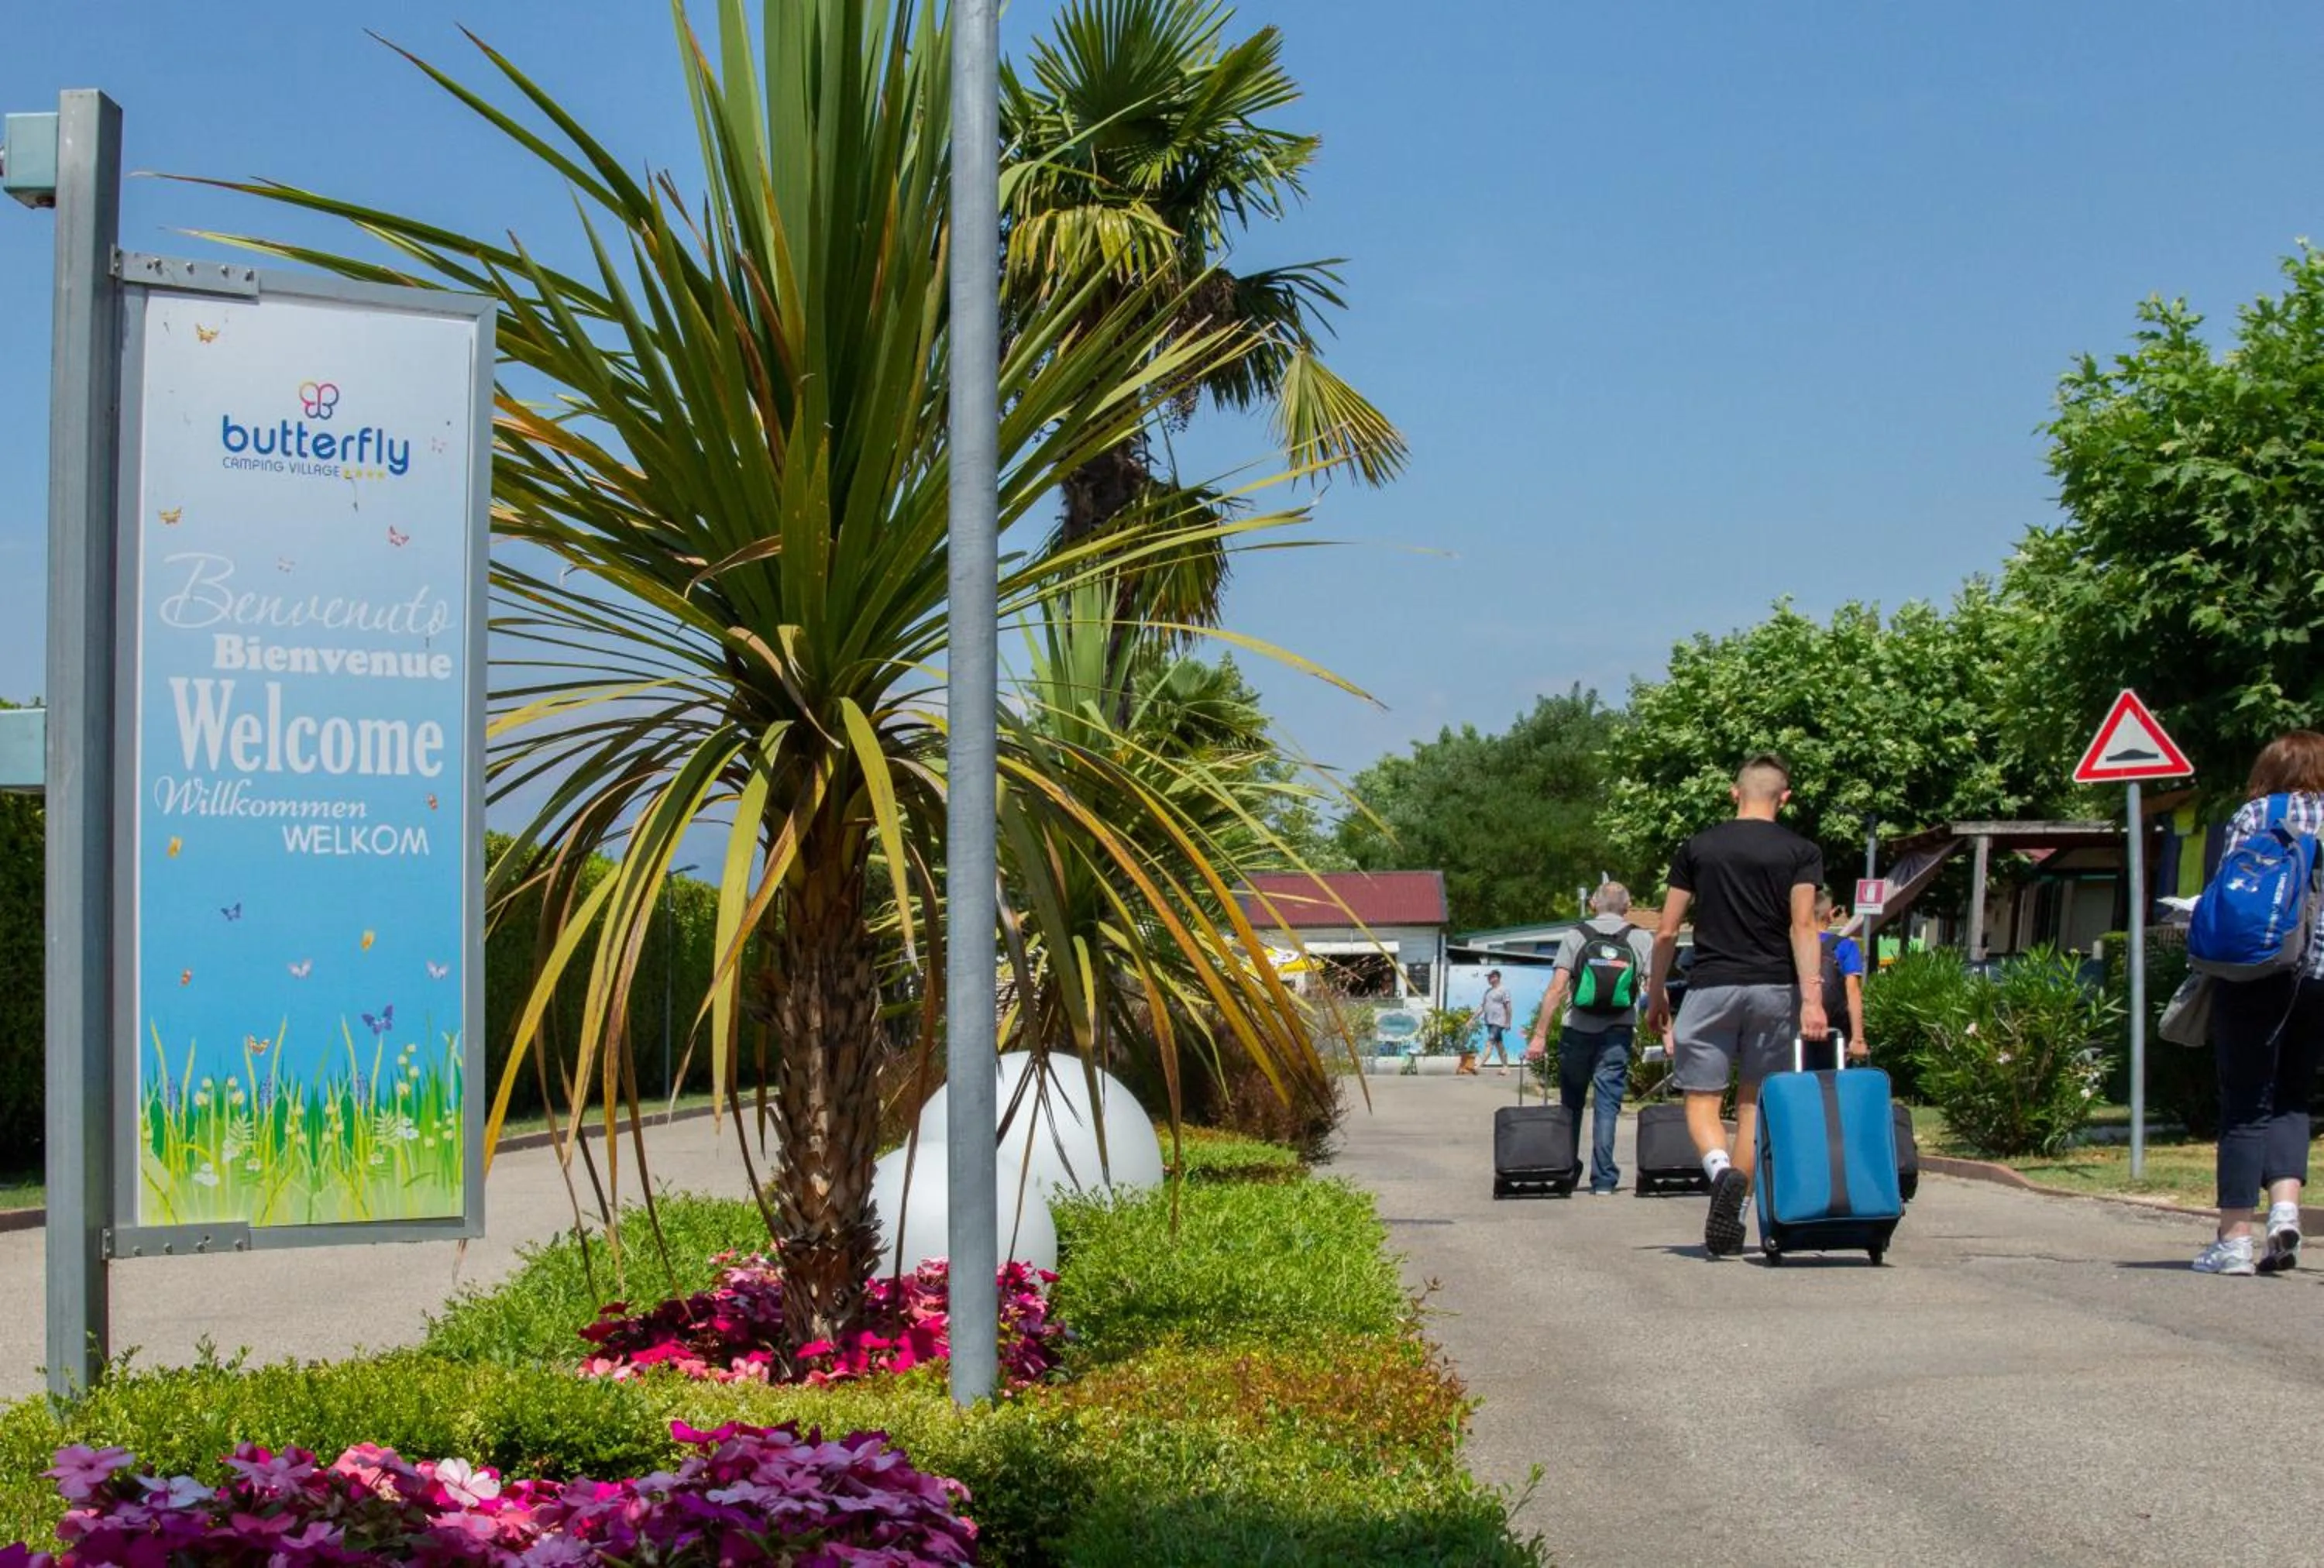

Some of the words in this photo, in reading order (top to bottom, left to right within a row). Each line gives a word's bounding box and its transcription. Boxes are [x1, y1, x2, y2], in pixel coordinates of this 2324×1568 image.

[222, 415, 410, 476] butterfly
[289, 462, 340, 477] VILLAGE
[160, 552, 456, 636] Benvenuto
[212, 633, 452, 679] Bienvenue
[169, 677, 445, 777] Welcome
[154, 775, 368, 820] Willkommen
[283, 825, 429, 855] WELKOM
